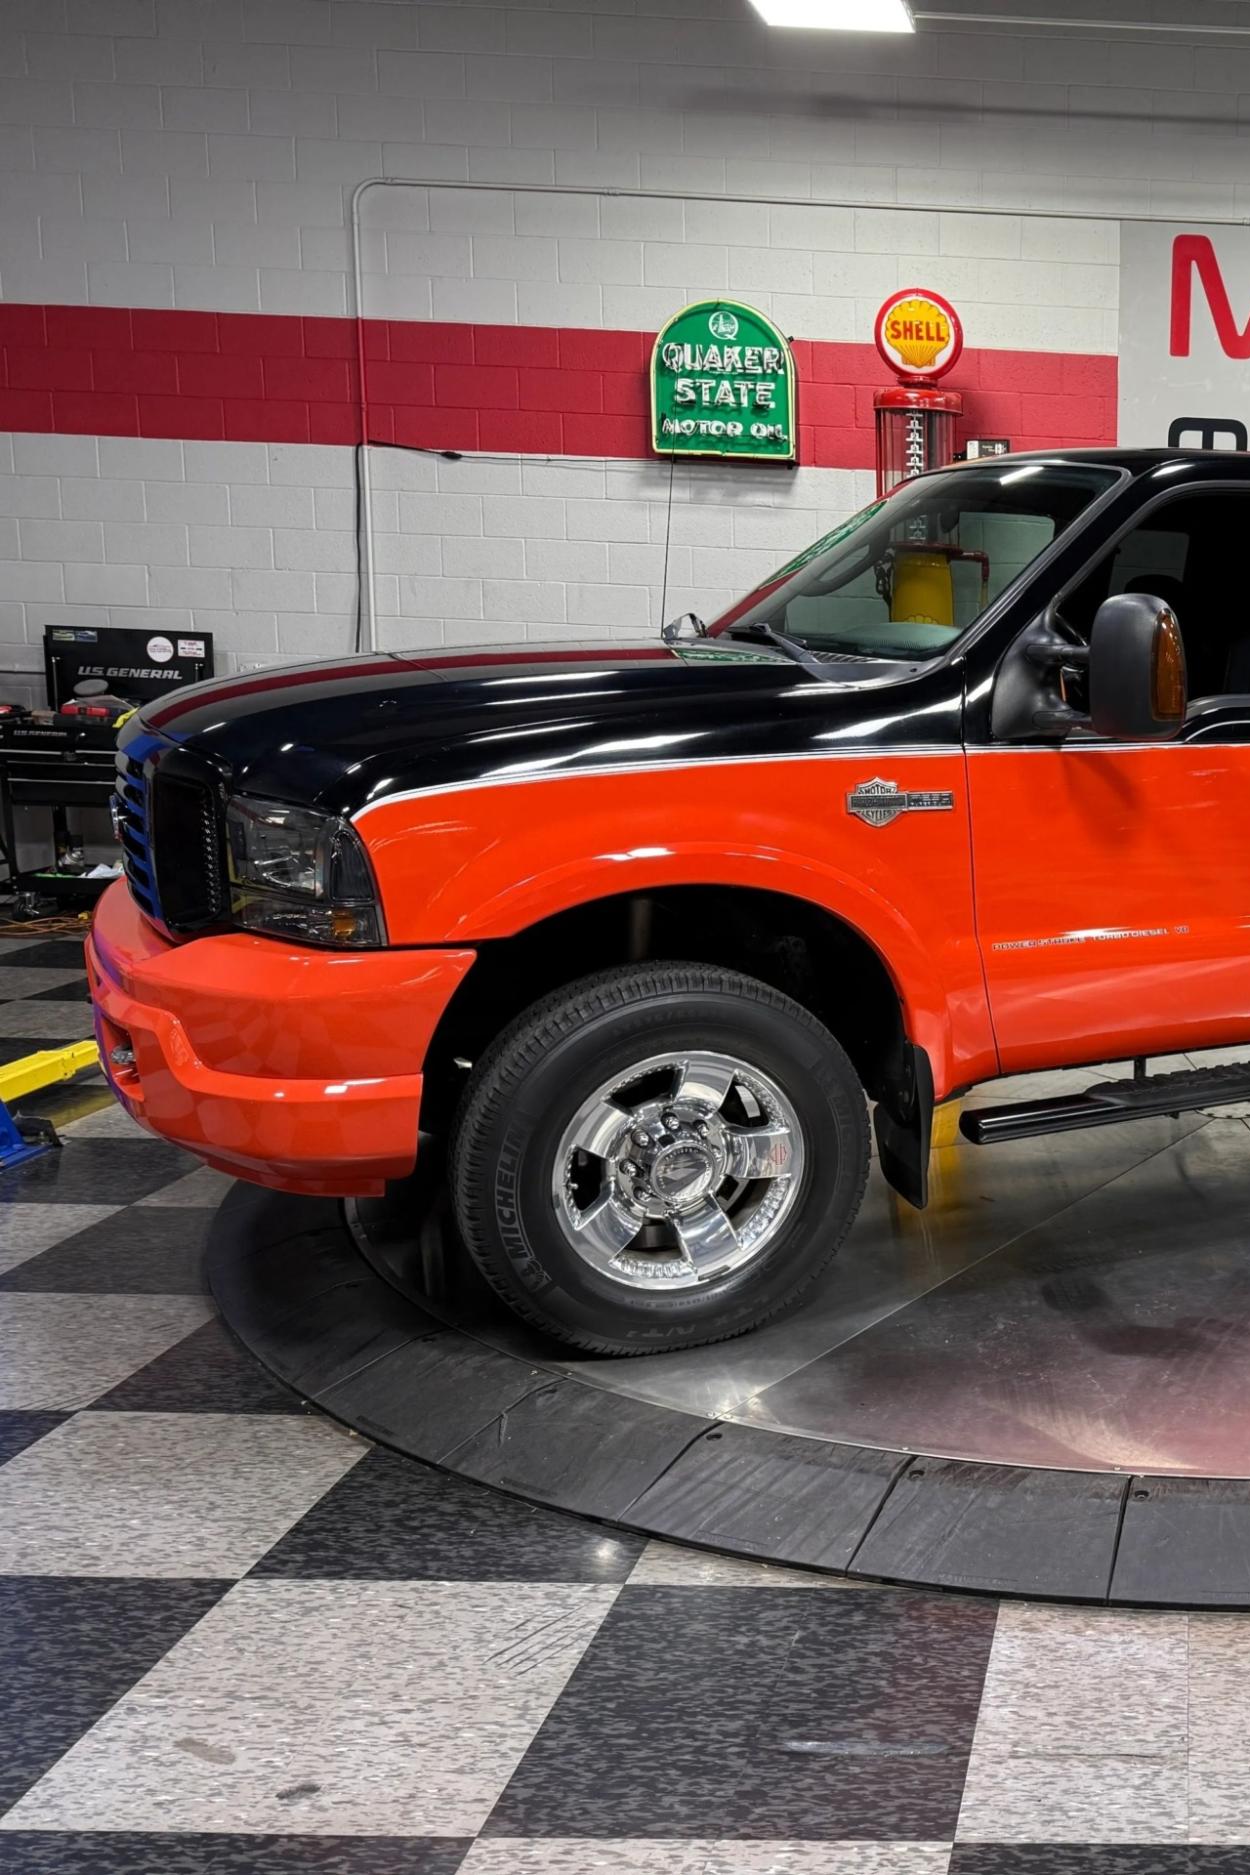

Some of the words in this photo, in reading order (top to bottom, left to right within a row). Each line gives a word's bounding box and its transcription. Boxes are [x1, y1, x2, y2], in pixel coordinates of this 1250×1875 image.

[890, 320, 946, 342] SHELL
[662, 342, 785, 375] QUAKER
[674, 378, 776, 409] STATE
[662, 418, 744, 437] MOTOR
[106, 667, 183, 680] GENERAL
[496, 1121, 529, 1260] MICHELIN
